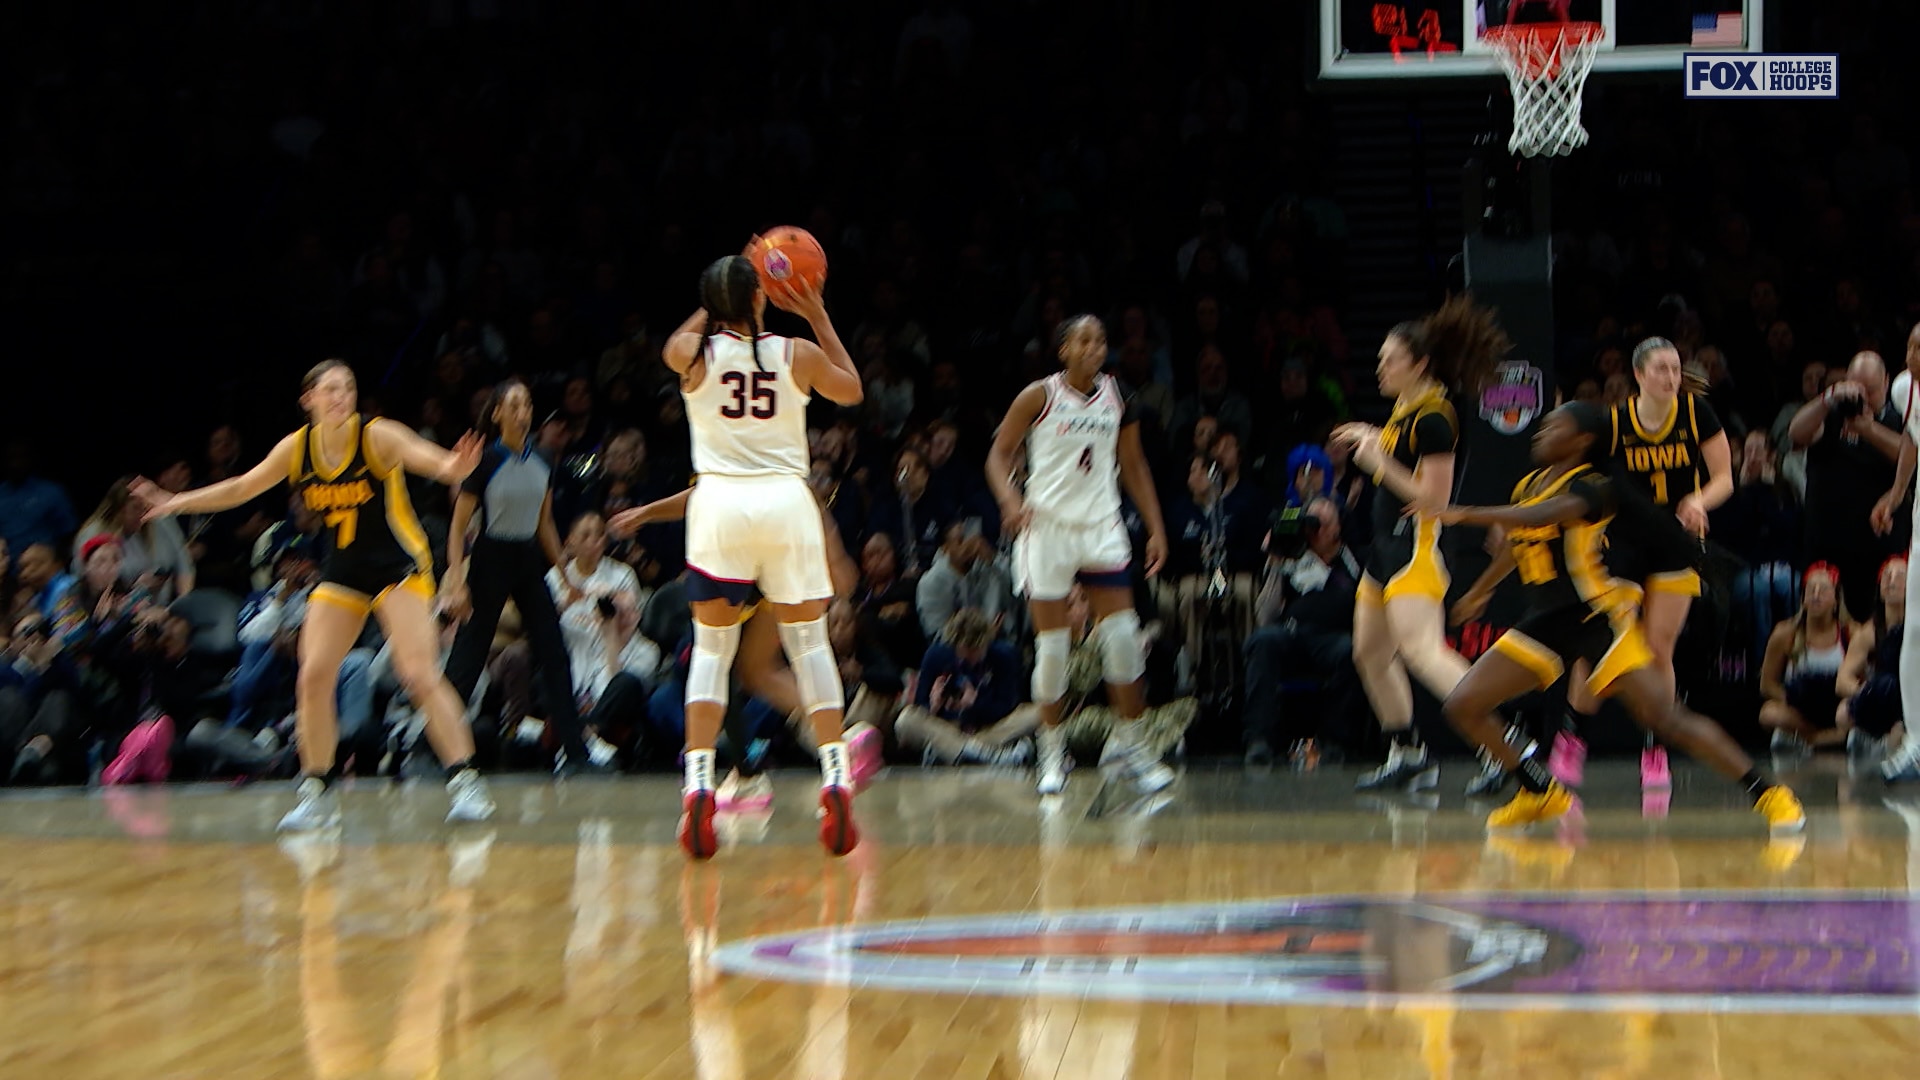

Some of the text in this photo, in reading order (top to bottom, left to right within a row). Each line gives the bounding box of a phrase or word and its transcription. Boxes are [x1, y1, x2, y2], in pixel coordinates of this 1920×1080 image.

[719, 370, 778, 420] 35
[1624, 441, 1691, 472] IOWA
[1650, 470, 1669, 504] 1
